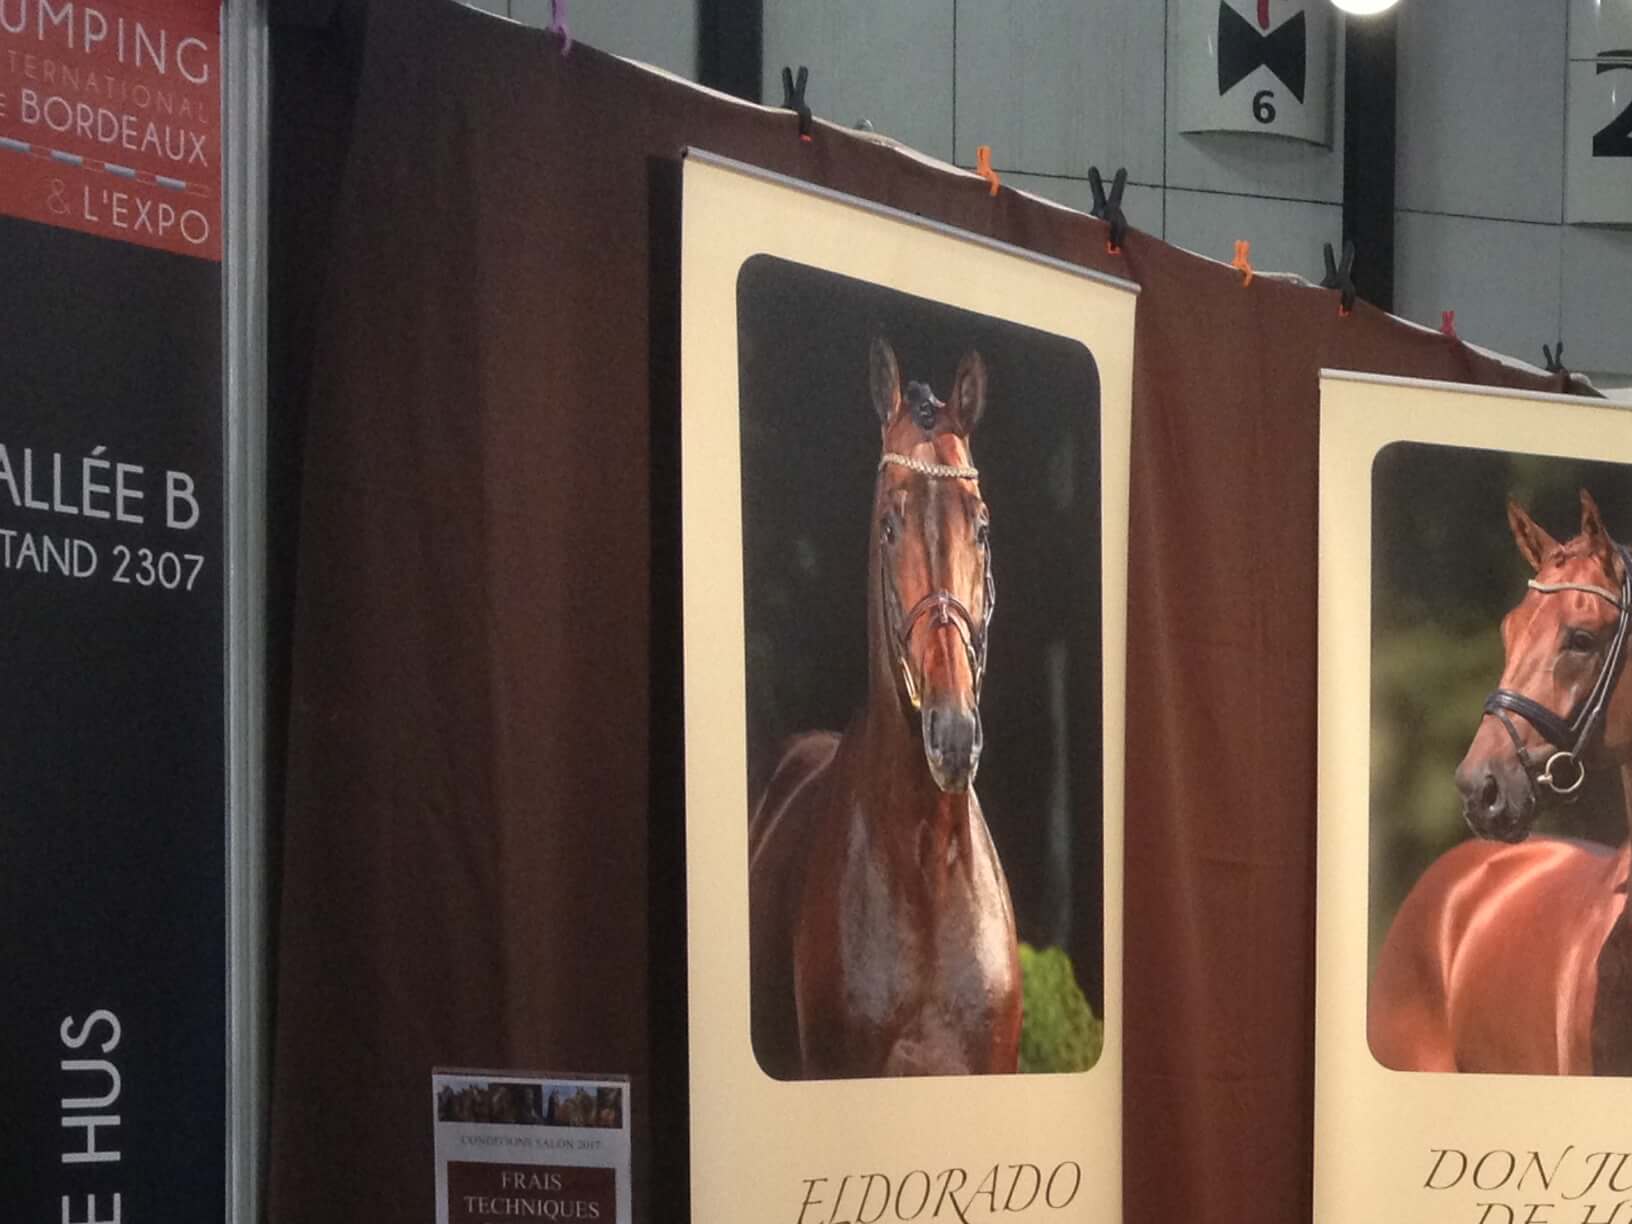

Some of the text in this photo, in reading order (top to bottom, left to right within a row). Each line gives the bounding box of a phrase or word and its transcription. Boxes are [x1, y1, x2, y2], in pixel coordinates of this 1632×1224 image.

[0, 0, 208, 83] UMPING
[8, 51, 207, 124] TERNATIONAL
[1252, 90, 1276, 124] 6
[21, 88, 208, 167] BORDEAUX
[84, 185, 209, 244] L'EXPO
[166, 470, 200, 529] B
[0, 529, 205, 591] TAND 2307
[60, 1008, 122, 1164] HUS
[501, 1171, 562, 1191] FRAIS
[1423, 1145, 1574, 1191] DON
[463, 1196, 600, 1220] TECHNIQUES
